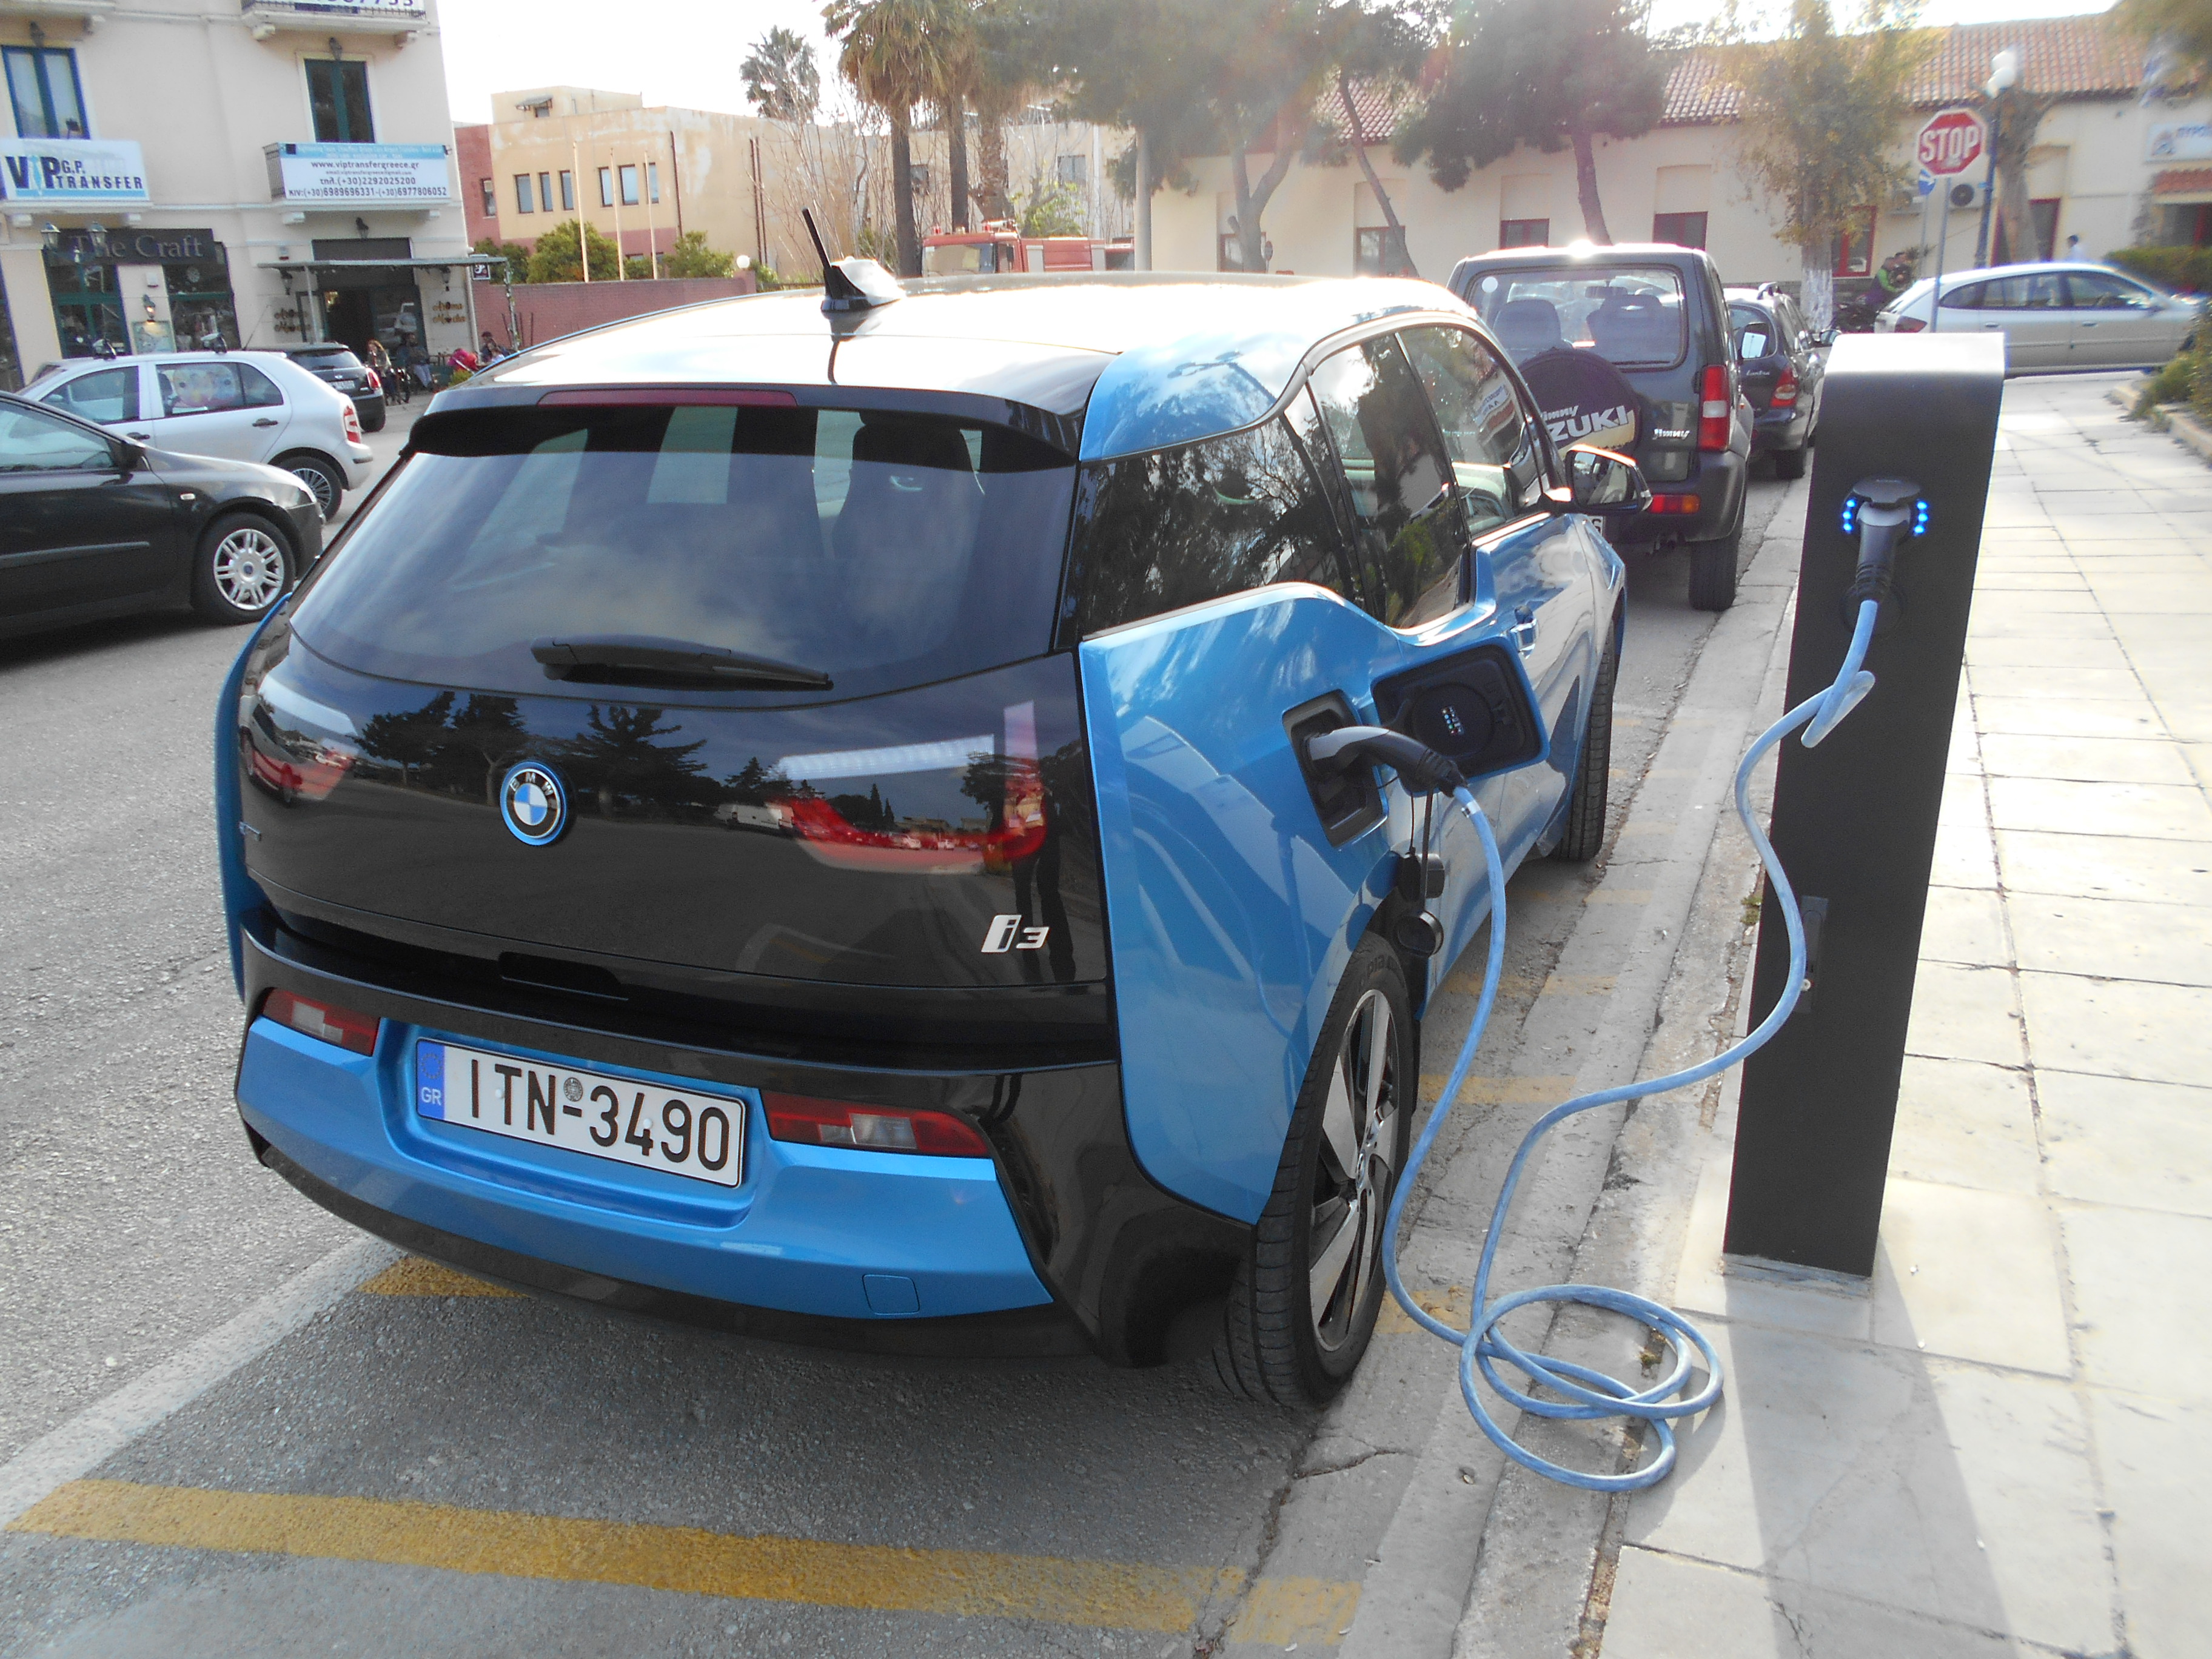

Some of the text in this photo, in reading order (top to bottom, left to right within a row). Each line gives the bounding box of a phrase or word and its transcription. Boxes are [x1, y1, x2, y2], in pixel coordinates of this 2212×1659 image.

[1920, 126, 1979, 163] STOP
[5, 155, 61, 192] VIP
[62, 160, 85, 175] G.P.
[311, 161, 420, 170] www.viptransfergreece.gr
[56, 175, 143, 189] TRANSFER
[135, 234, 204, 258] Craft
[1543, 405, 1579, 421] imny
[1546, 405, 1629, 443] ZUKI
[1652, 428, 1690, 440] Jimny
[509, 772, 554, 796] BMW
[981, 914, 1050, 953] i3
[421, 1087, 441, 1105] GR
